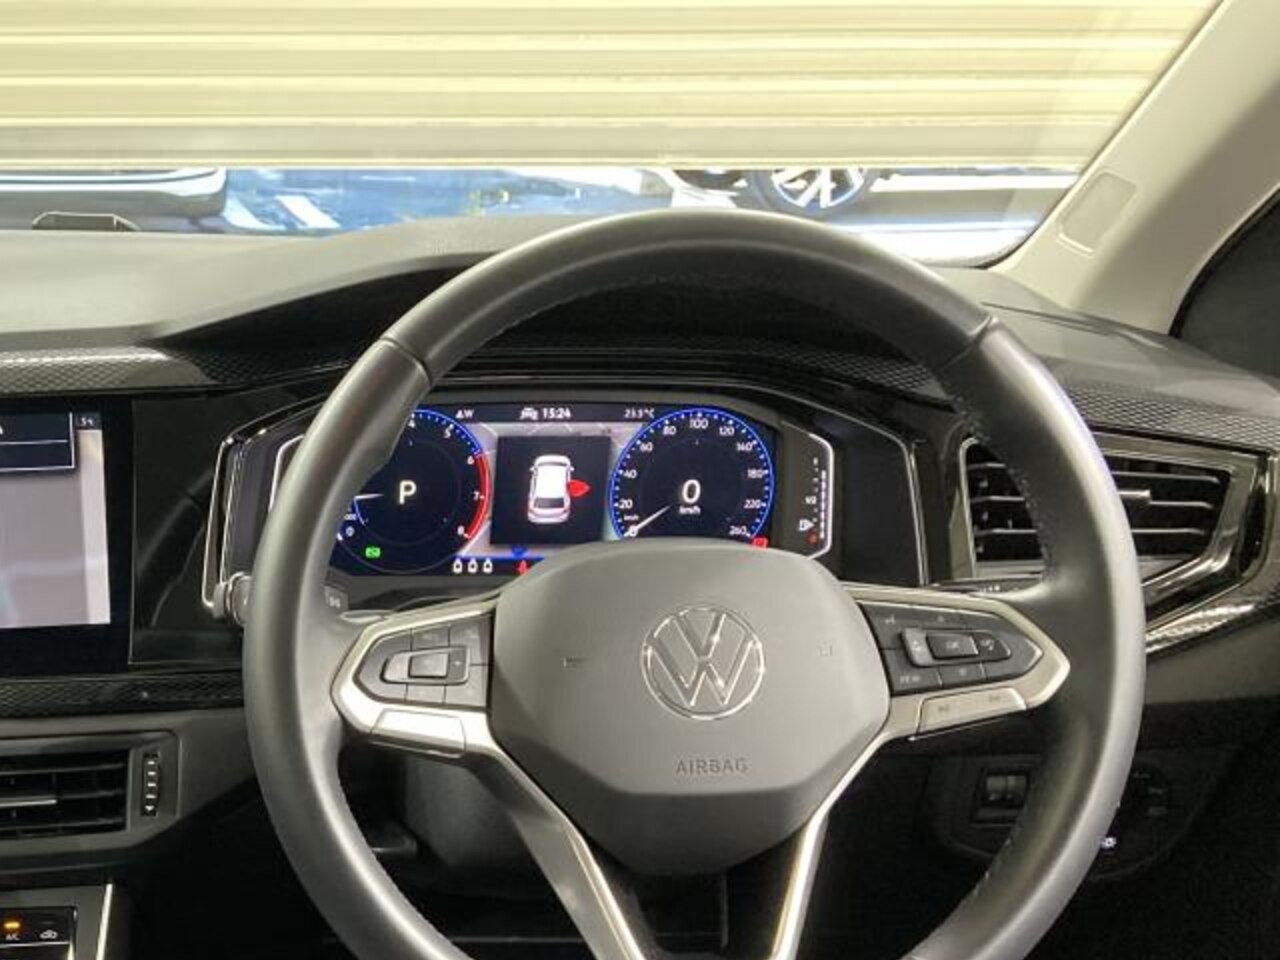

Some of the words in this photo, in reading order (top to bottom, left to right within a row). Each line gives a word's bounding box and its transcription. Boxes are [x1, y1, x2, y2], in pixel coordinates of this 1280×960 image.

[542, 407, 572, 419] 15:24
[689, 419, 709, 430] 100
[662, 426, 677, 436] 80
[719, 426, 735, 436] 120
[639, 442, 653, 452] 60
[623, 469, 637, 479] 40
[747, 469, 762, 479] 180
[398, 480, 417, 505] P
[682, 479, 701, 504] 0
[619, 500, 633, 509] 20
[743, 500, 761, 510] 220
[678, 504, 701, 516] km/h
[728, 525, 747, 537] 260
[675, 757, 750, 776] AIRBAG
